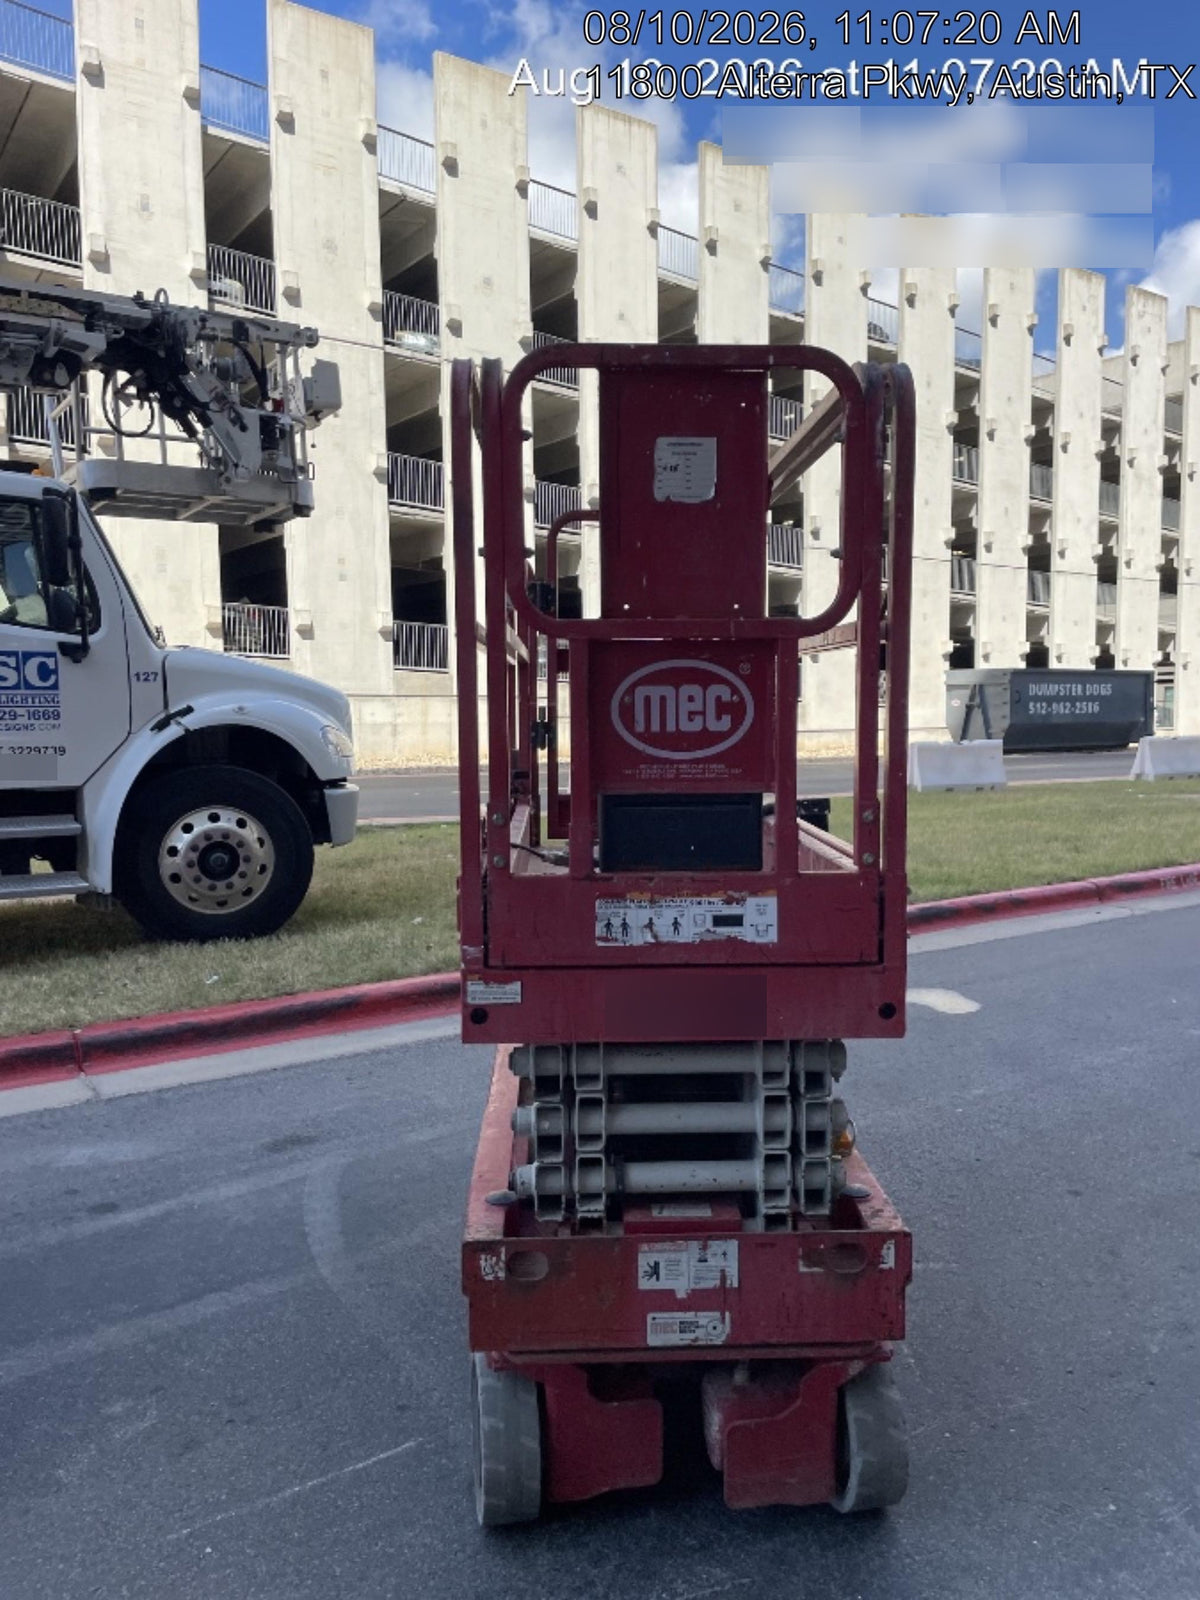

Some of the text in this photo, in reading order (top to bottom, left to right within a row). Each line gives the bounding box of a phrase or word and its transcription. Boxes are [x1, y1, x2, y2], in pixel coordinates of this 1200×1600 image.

[134, 671, 159, 682] 127
[1028, 683, 1113, 696] DUMPSTER DOGS
